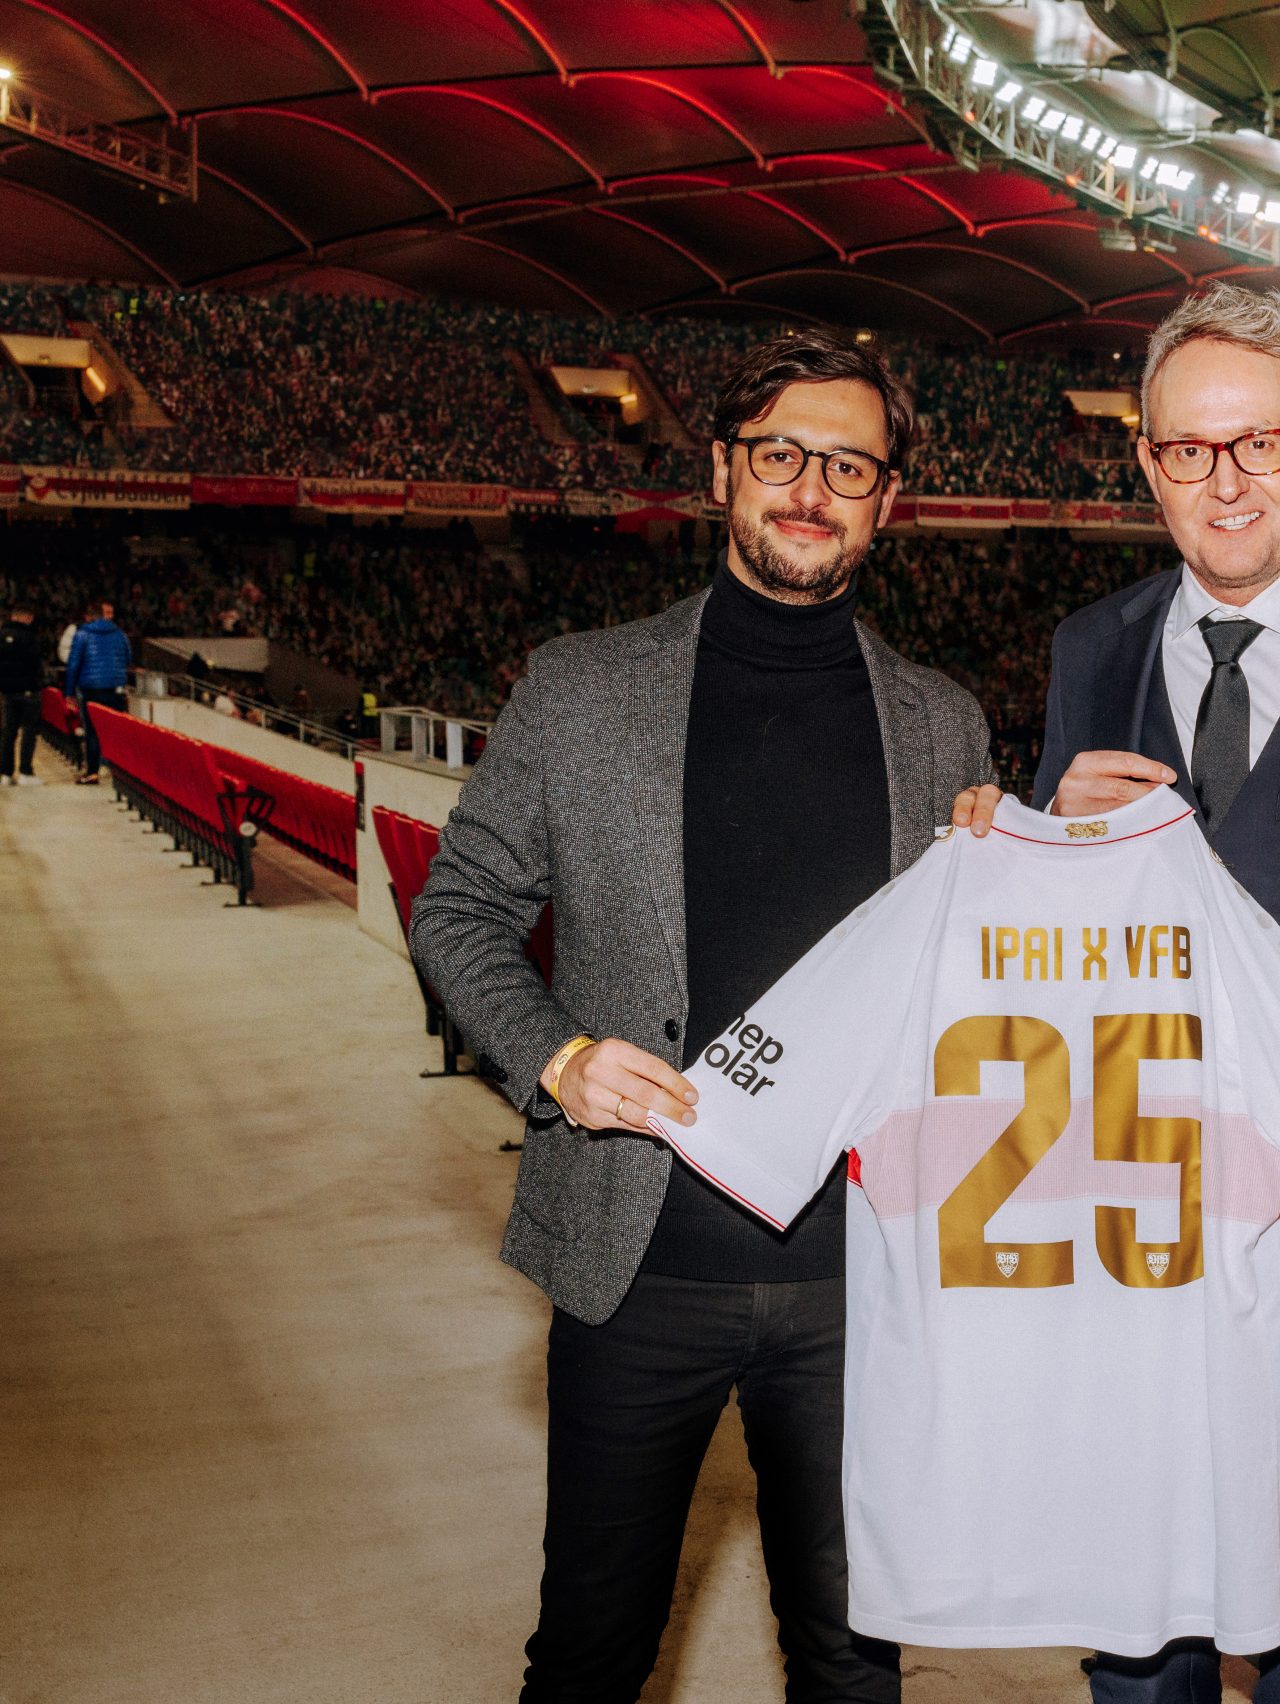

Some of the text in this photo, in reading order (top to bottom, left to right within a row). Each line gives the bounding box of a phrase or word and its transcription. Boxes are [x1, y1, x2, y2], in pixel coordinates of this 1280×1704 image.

[981, 925, 1192, 981] IPAI X VFB
[934, 1014, 1204, 1288] 25
